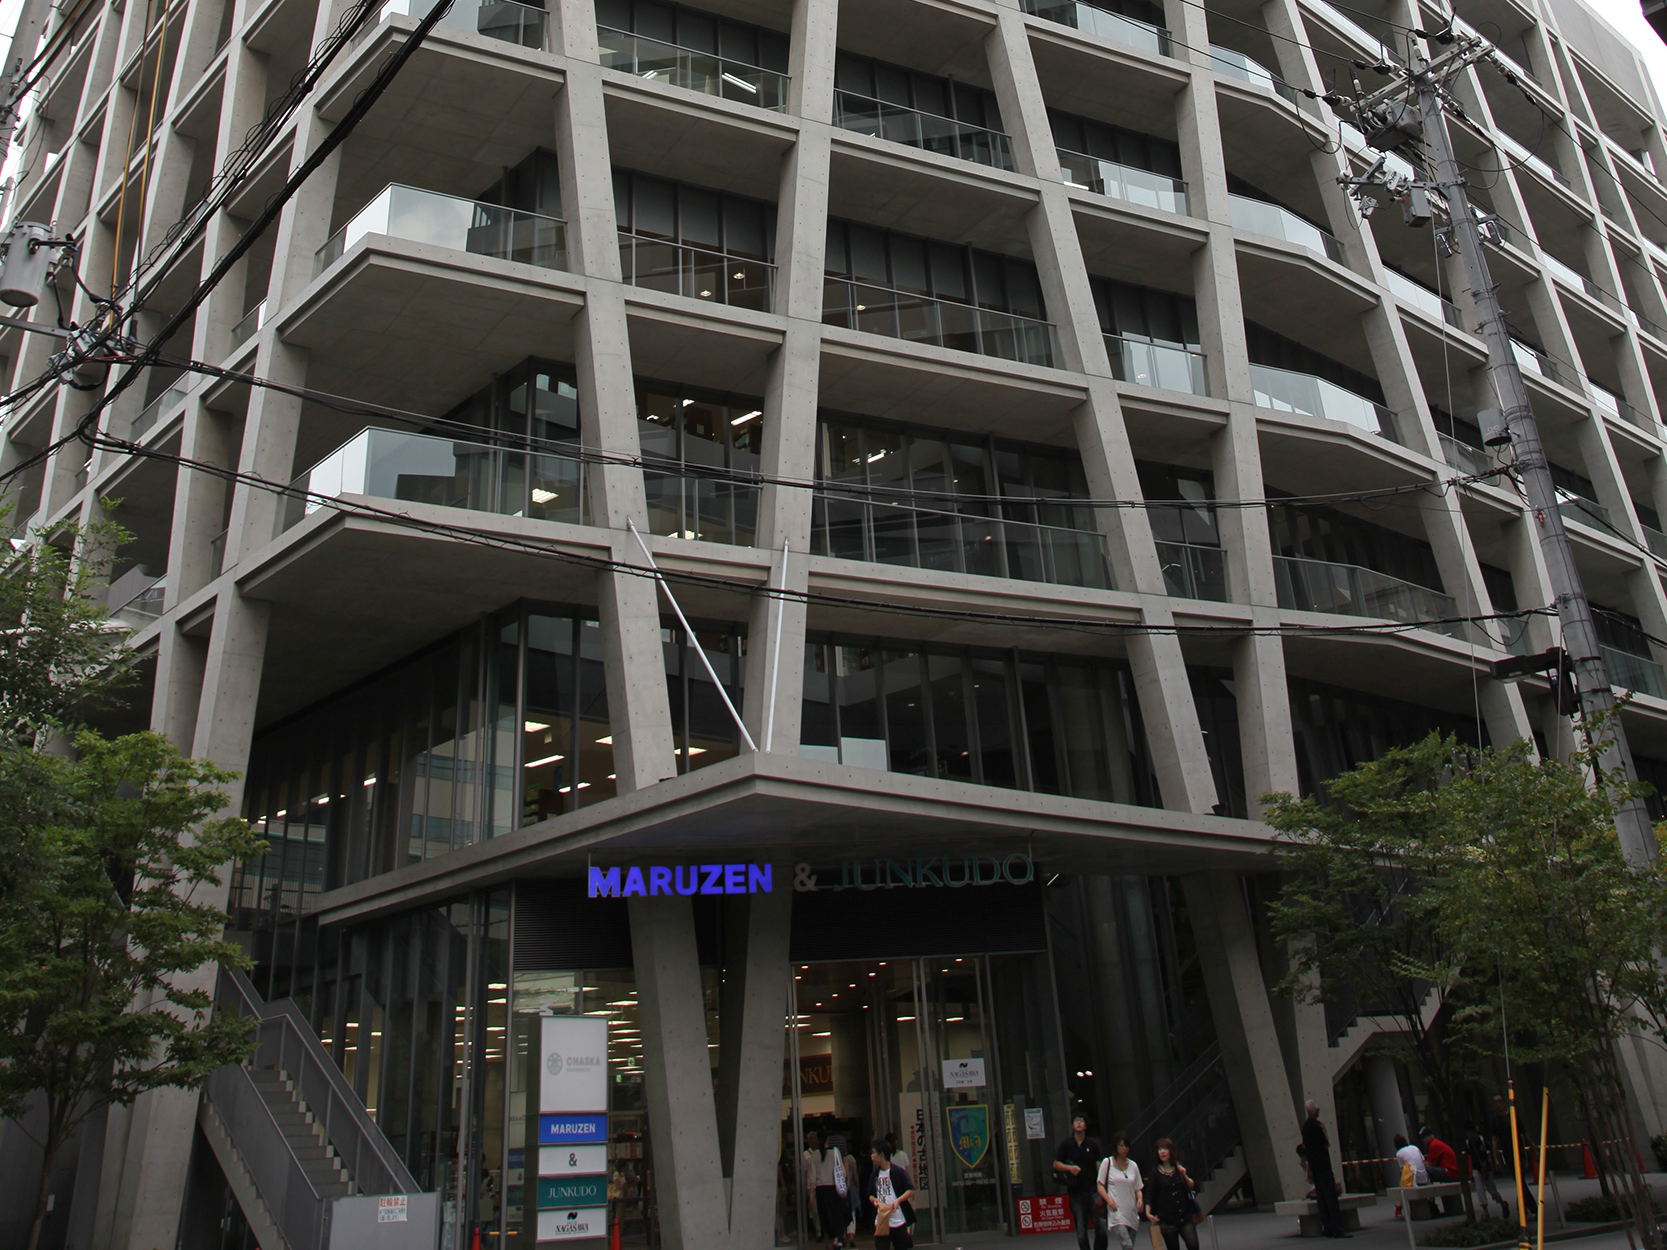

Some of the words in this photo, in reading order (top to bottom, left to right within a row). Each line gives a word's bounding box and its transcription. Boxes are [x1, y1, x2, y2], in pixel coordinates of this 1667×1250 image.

[588, 864, 773, 898] MARUZEN
[793, 863, 819, 892] &
[833, 853, 1035, 892] JUNKUDO
[566, 1056, 600, 1066] CHASKA
[550, 1123, 596, 1135] MARUZEN
[568, 1153, 578, 1167] &
[548, 1185, 597, 1198] JUNKUDO
